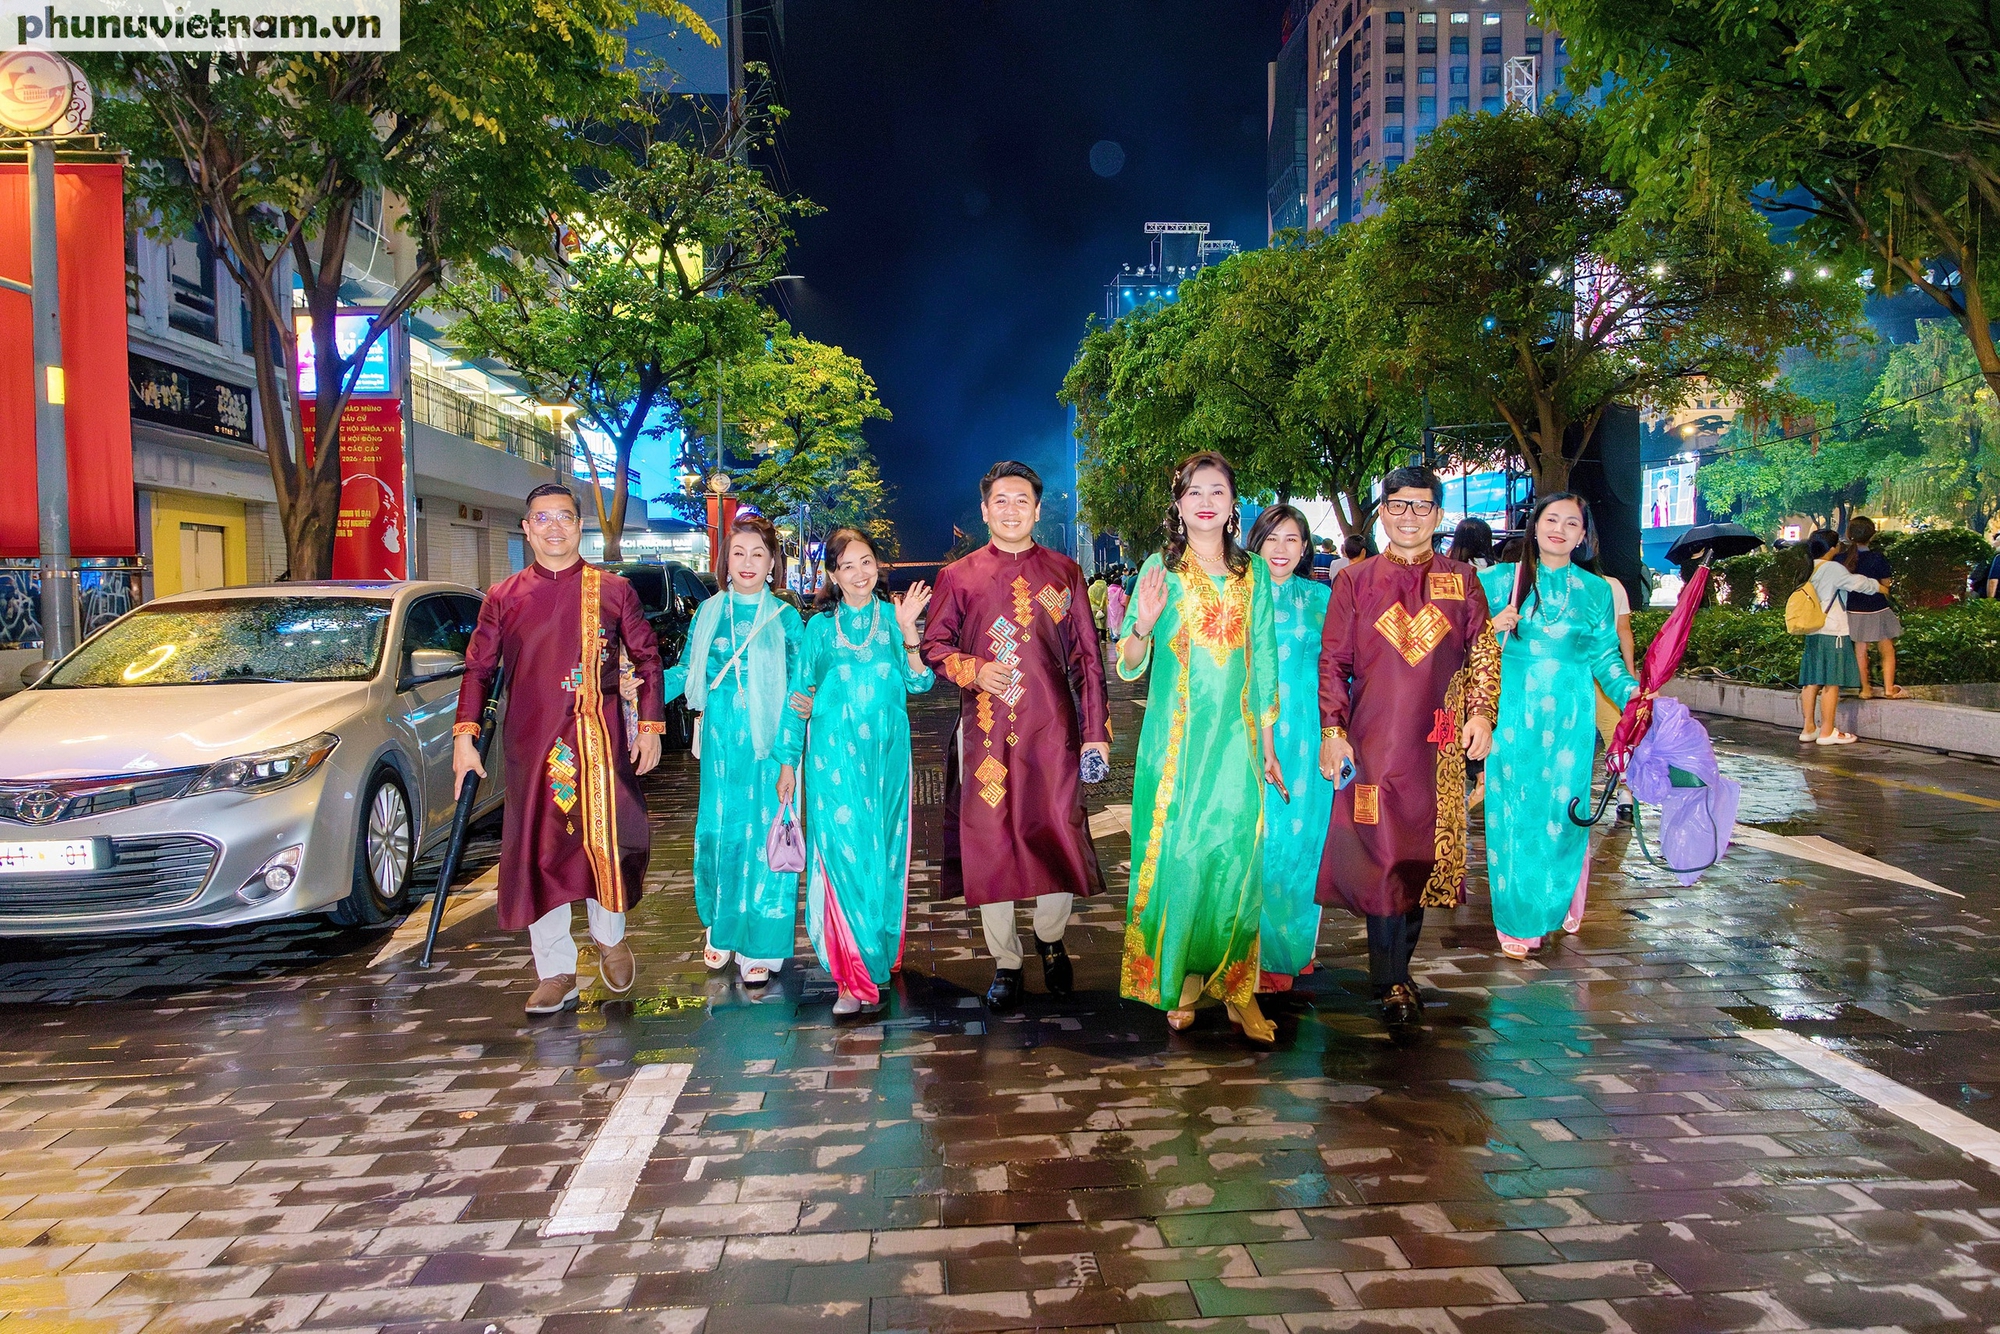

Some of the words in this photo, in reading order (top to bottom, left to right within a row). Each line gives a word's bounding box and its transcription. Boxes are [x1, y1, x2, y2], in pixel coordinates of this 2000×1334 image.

[344, 404, 359, 412] HÀO
[346, 426, 359, 434] HỘI
[347, 435, 360, 443] HỘI
[347, 444, 363, 452] CÁC
